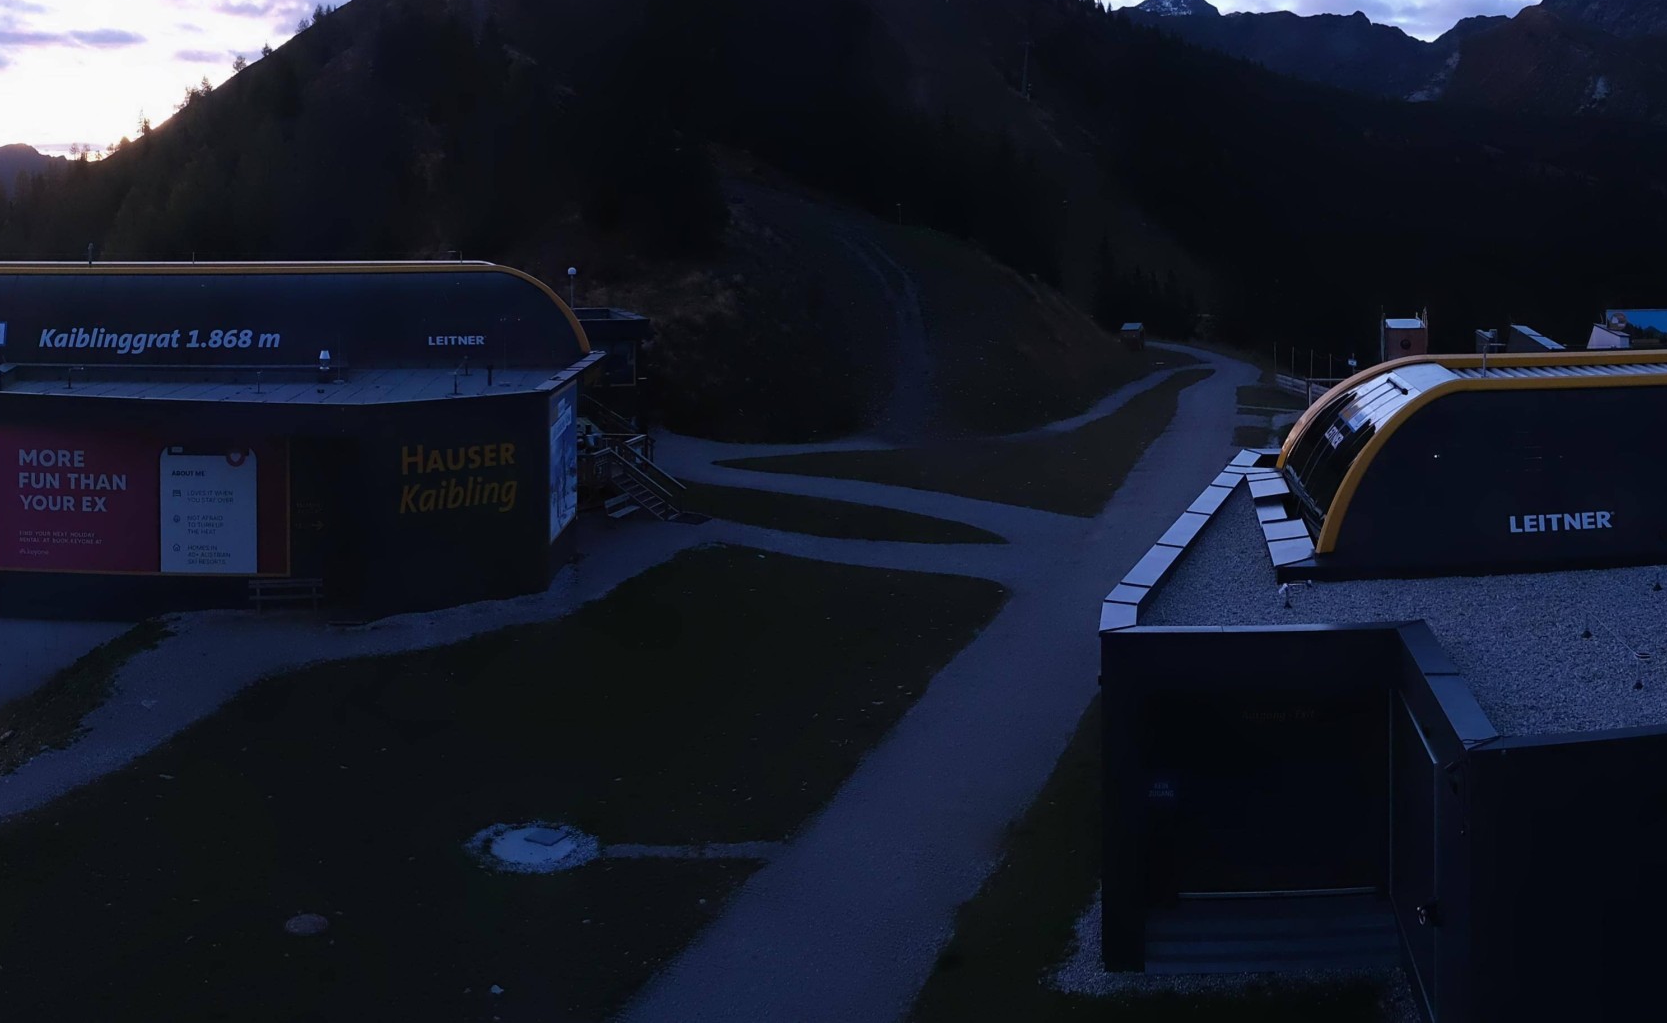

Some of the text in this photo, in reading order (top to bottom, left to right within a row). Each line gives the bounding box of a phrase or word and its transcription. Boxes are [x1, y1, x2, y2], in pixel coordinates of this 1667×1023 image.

[38, 327, 281, 355] Kaiblinggrat 1.868 m
[428, 335, 485, 346] LEITNER
[18, 448, 85, 468] MORE
[18, 472, 127, 491] FUN THAN
[20, 495, 108, 512] YOUR EX
[399, 476, 518, 514] Kaibling
[1509, 510, 1613, 533] LEITNER
